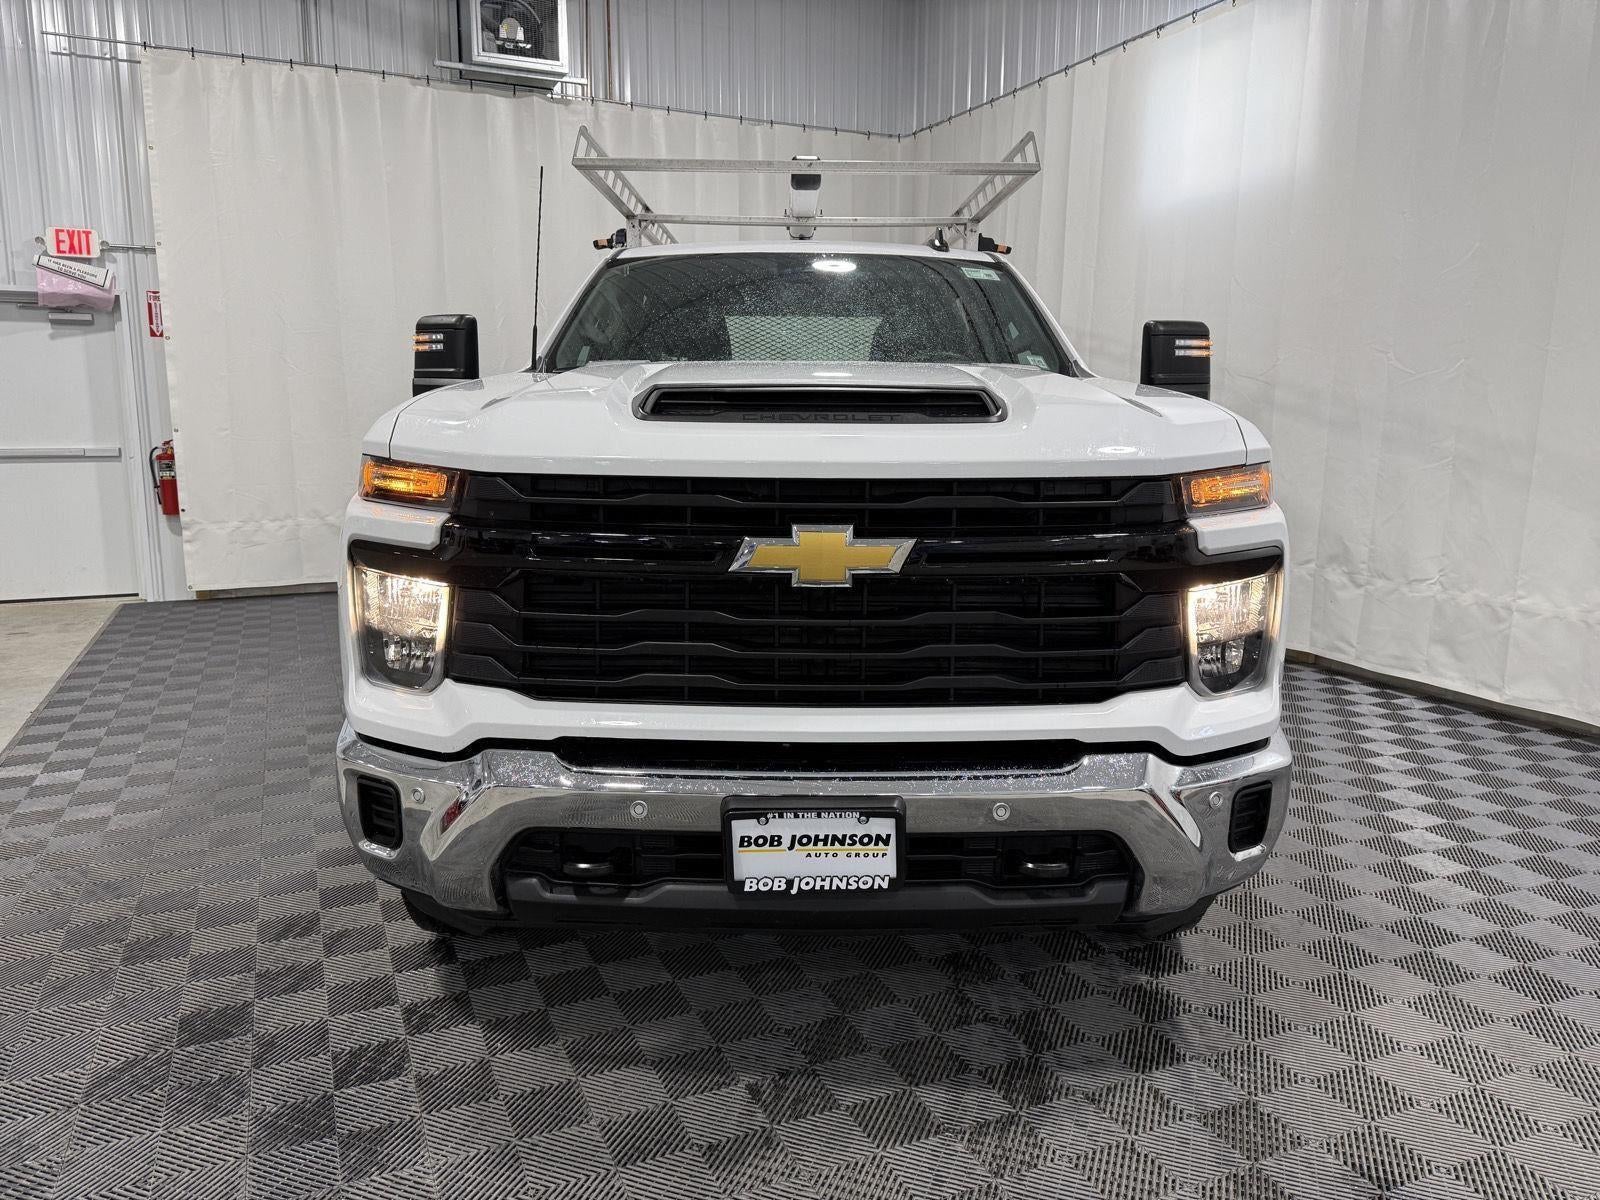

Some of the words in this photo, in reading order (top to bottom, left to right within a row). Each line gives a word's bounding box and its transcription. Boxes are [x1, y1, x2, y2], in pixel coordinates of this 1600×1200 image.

[54, 228, 92, 255] EXIT
[63, 269, 77, 277] SERVE
[76, 268, 98, 278] PLEASURE
[742, 413, 899, 422] CHEVROLET
[821, 811, 860, 819] NATION
[738, 835, 783, 848] BOB
[787, 833, 892, 850] JOHNSON
[744, 876, 787, 892] BOB
[790, 875, 890, 895] JOHNSON
